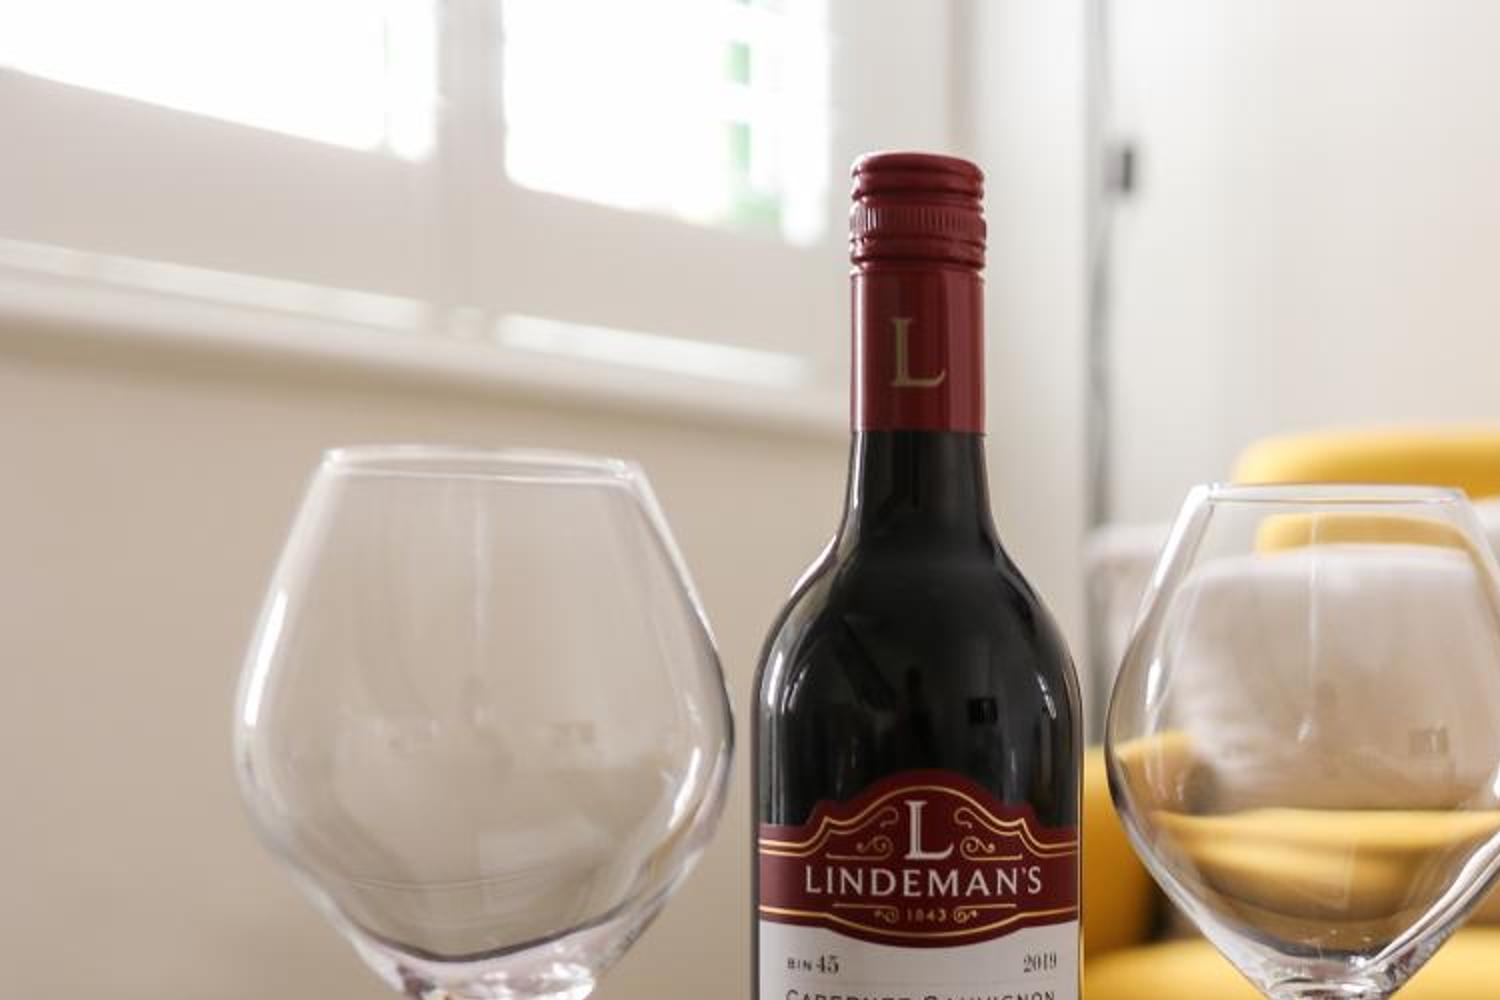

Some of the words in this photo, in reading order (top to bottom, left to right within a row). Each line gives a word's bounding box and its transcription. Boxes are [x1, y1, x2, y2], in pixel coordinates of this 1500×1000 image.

[891, 317, 946, 387] L
[904, 800, 954, 860] L
[805, 866, 1042, 898] LINDEMAN'S
[787, 957, 813, 971] BIN
[816, 954, 840, 974] 45
[1023, 952, 1057, 973] 2019
